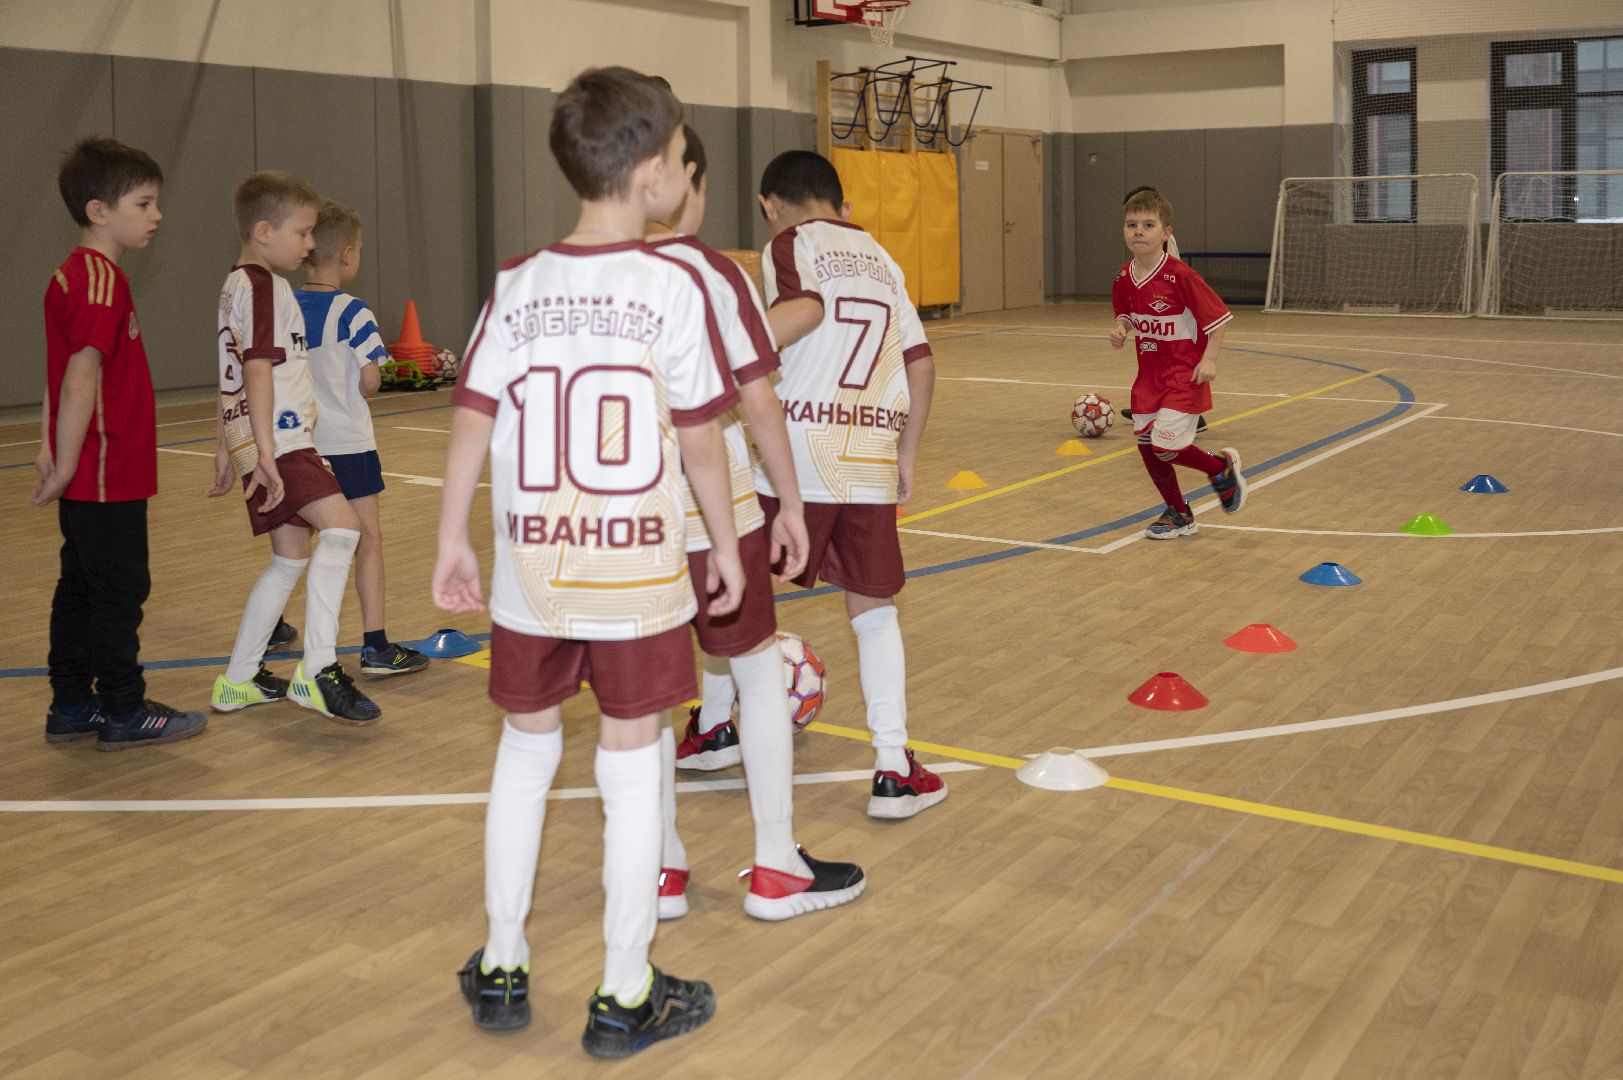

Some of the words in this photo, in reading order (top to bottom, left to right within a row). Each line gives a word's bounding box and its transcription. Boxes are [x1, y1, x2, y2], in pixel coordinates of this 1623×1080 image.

[835, 297, 891, 390] 7
[1134, 318, 1175, 337] ОЙЛ
[507, 365, 664, 496] 10
